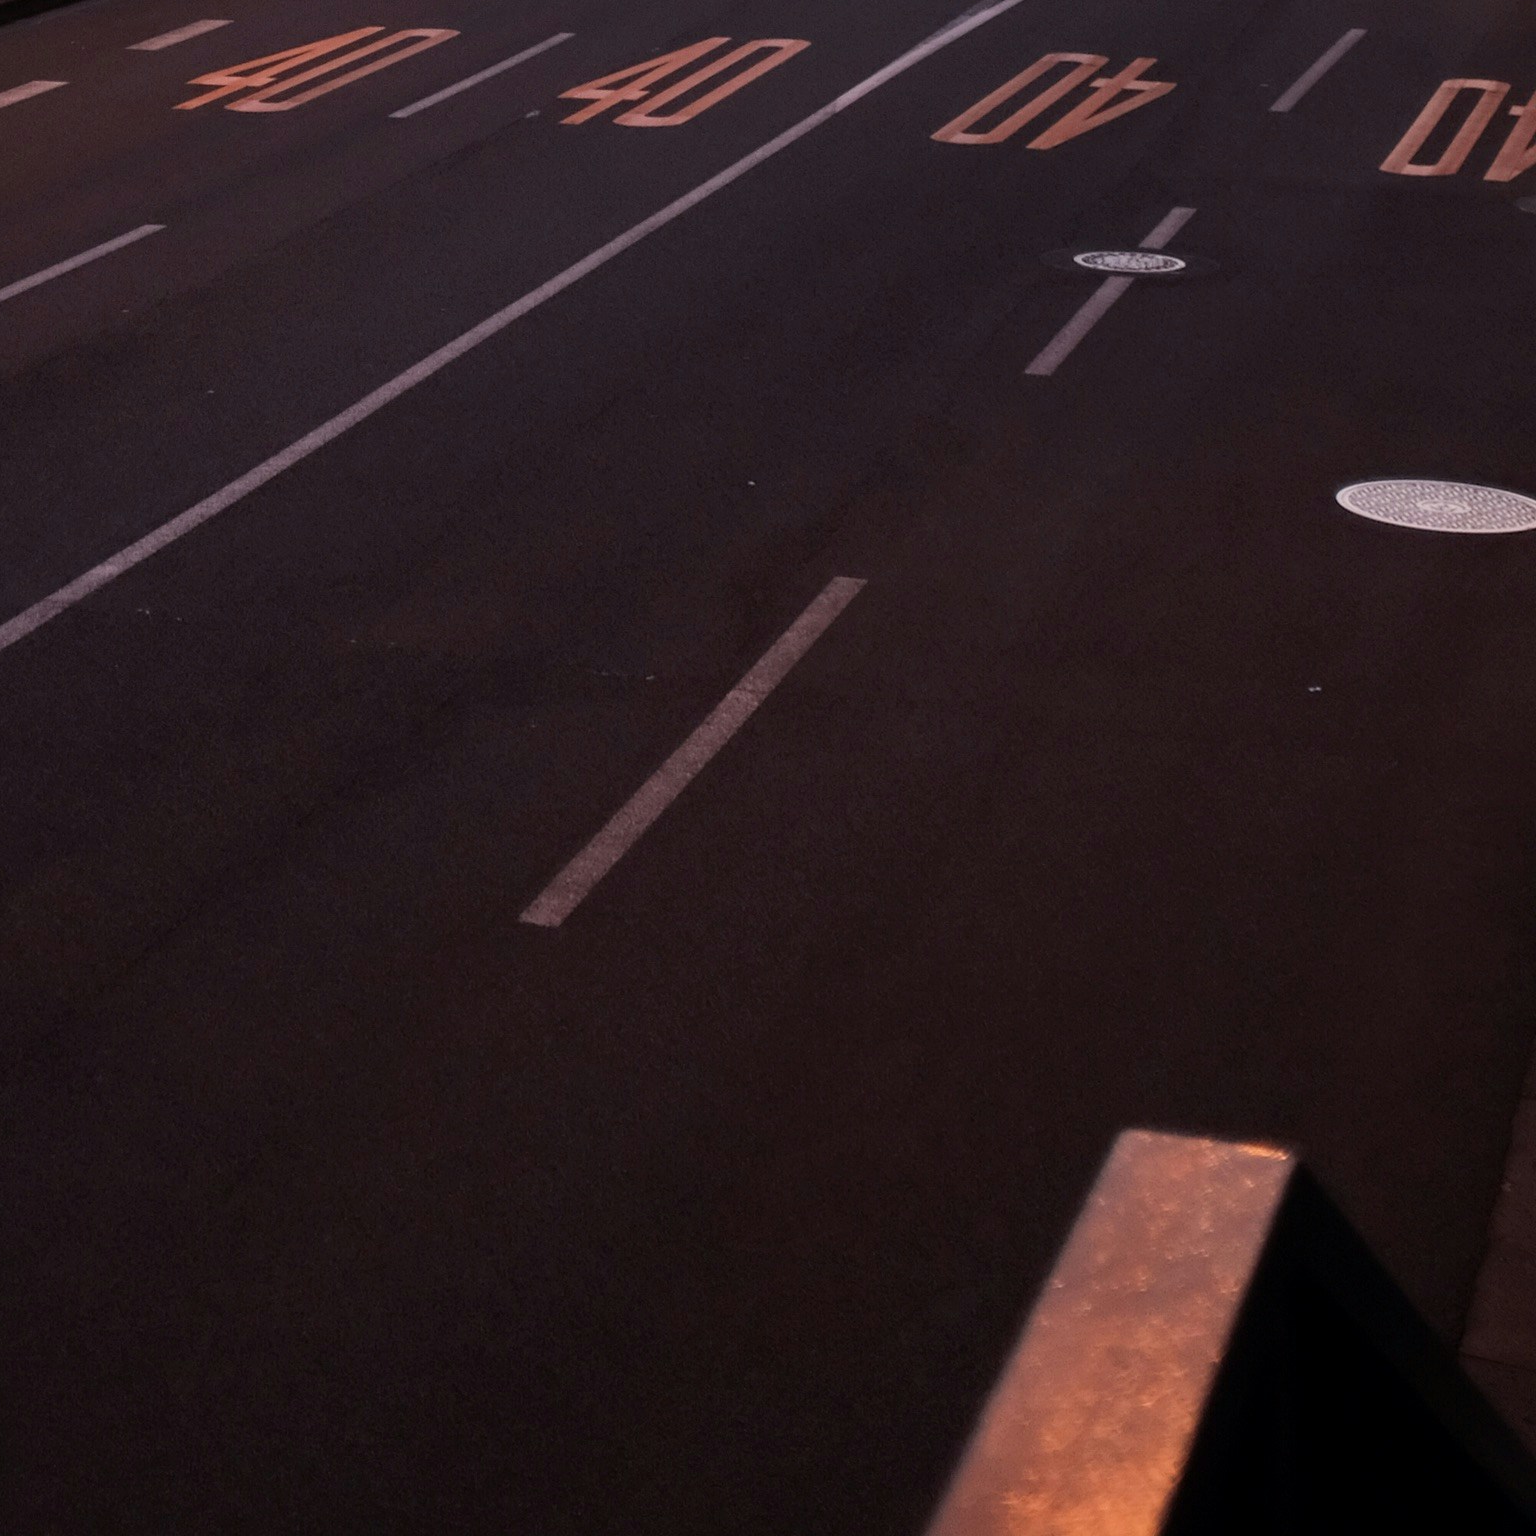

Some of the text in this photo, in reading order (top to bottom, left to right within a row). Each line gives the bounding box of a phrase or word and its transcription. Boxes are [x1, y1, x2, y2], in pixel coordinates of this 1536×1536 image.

[172, 26, 461, 112] 40
[558, 36, 812, 127] 40
[930, 52, 1177, 150] 40
